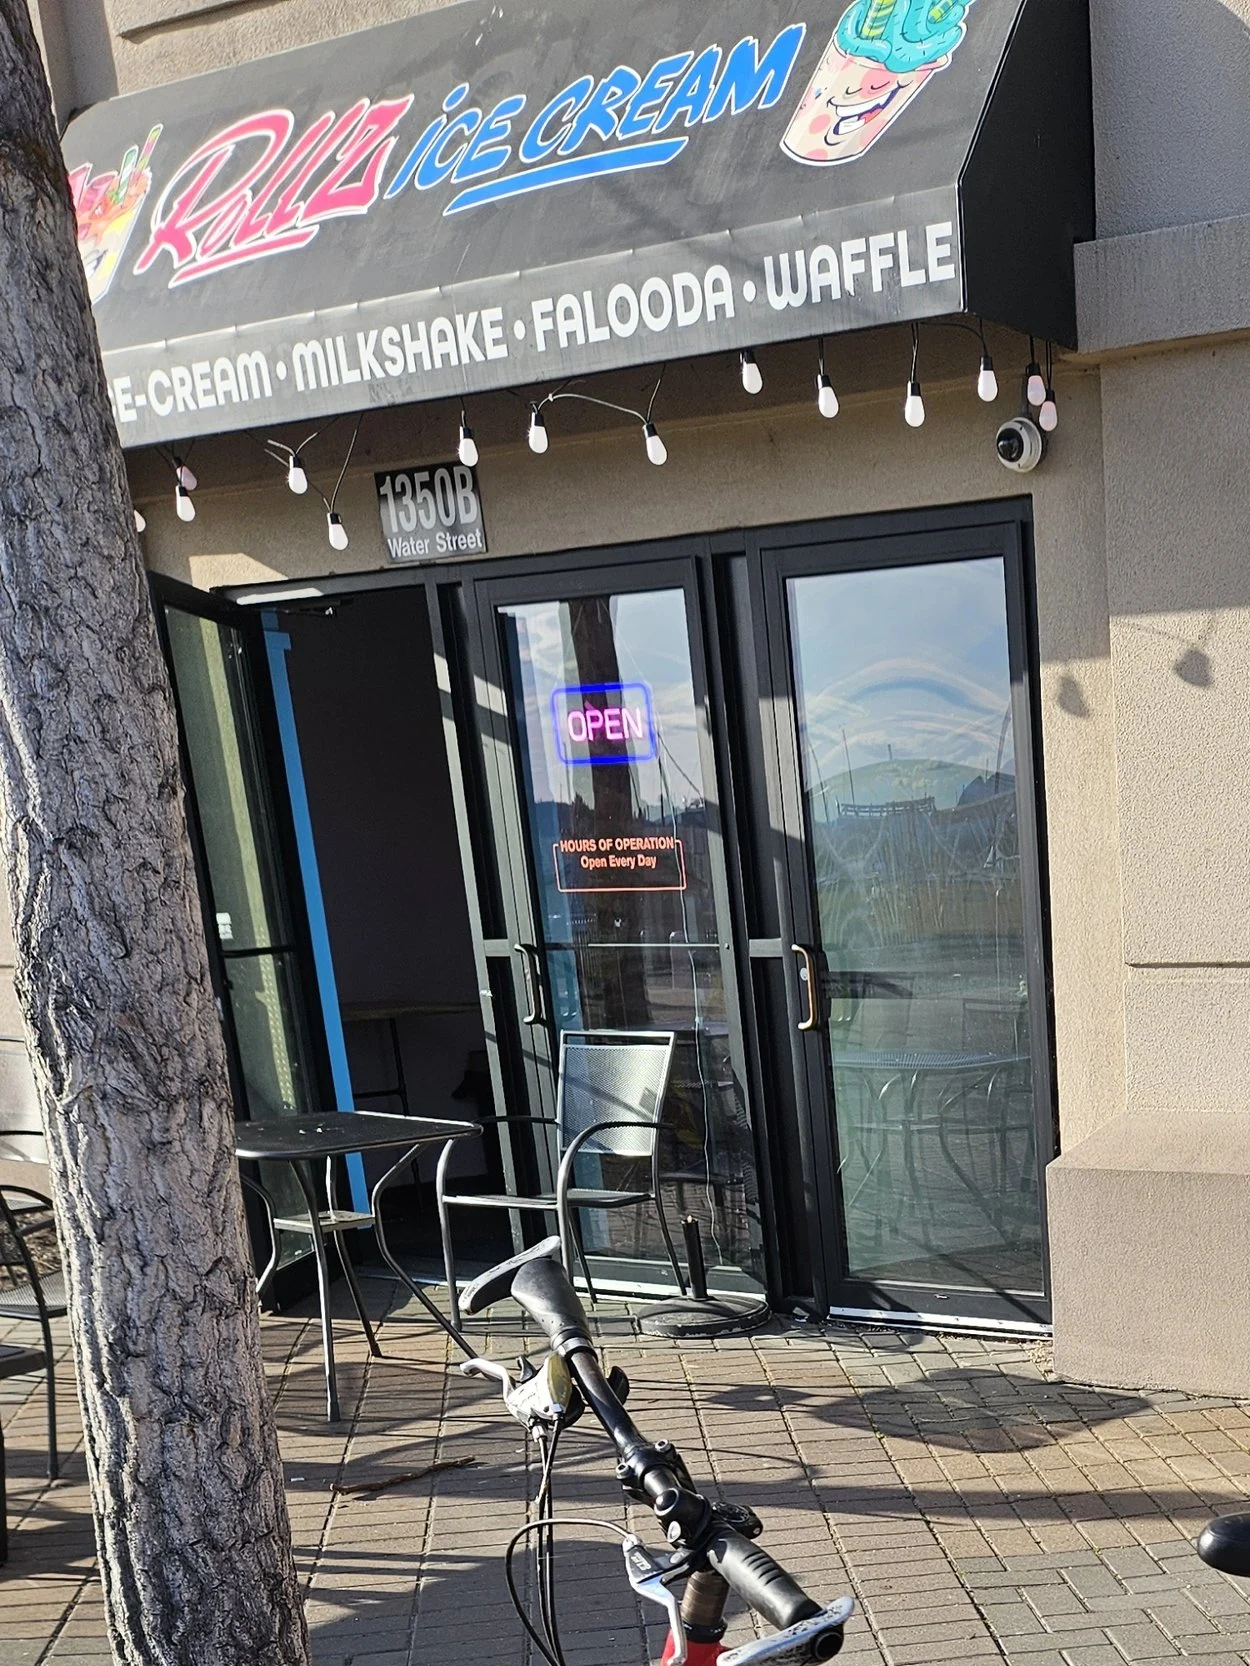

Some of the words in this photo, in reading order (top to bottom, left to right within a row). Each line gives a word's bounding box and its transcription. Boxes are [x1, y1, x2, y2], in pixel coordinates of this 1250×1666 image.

[518, 22, 807, 165] CREAM
[108, 350, 272, 423] E-CREAM
[291, 307, 509, 392] MILKSHAKE
[531, 264, 736, 353] FALOODA
[763, 221, 956, 311] WAFFLE
[380, 465, 478, 533] 1350B
[387, 536, 430, 558] Water
[435, 528, 483, 553] Street
[567, 707, 644, 742] OPEN
[560, 839, 597, 853] HOURS
[598, 838, 613, 852] OF
[615, 836, 675, 851] OPERATION
[580, 855, 607, 870] Open
[608, 854, 636, 870] Every
[637, 853, 657, 869] Day
